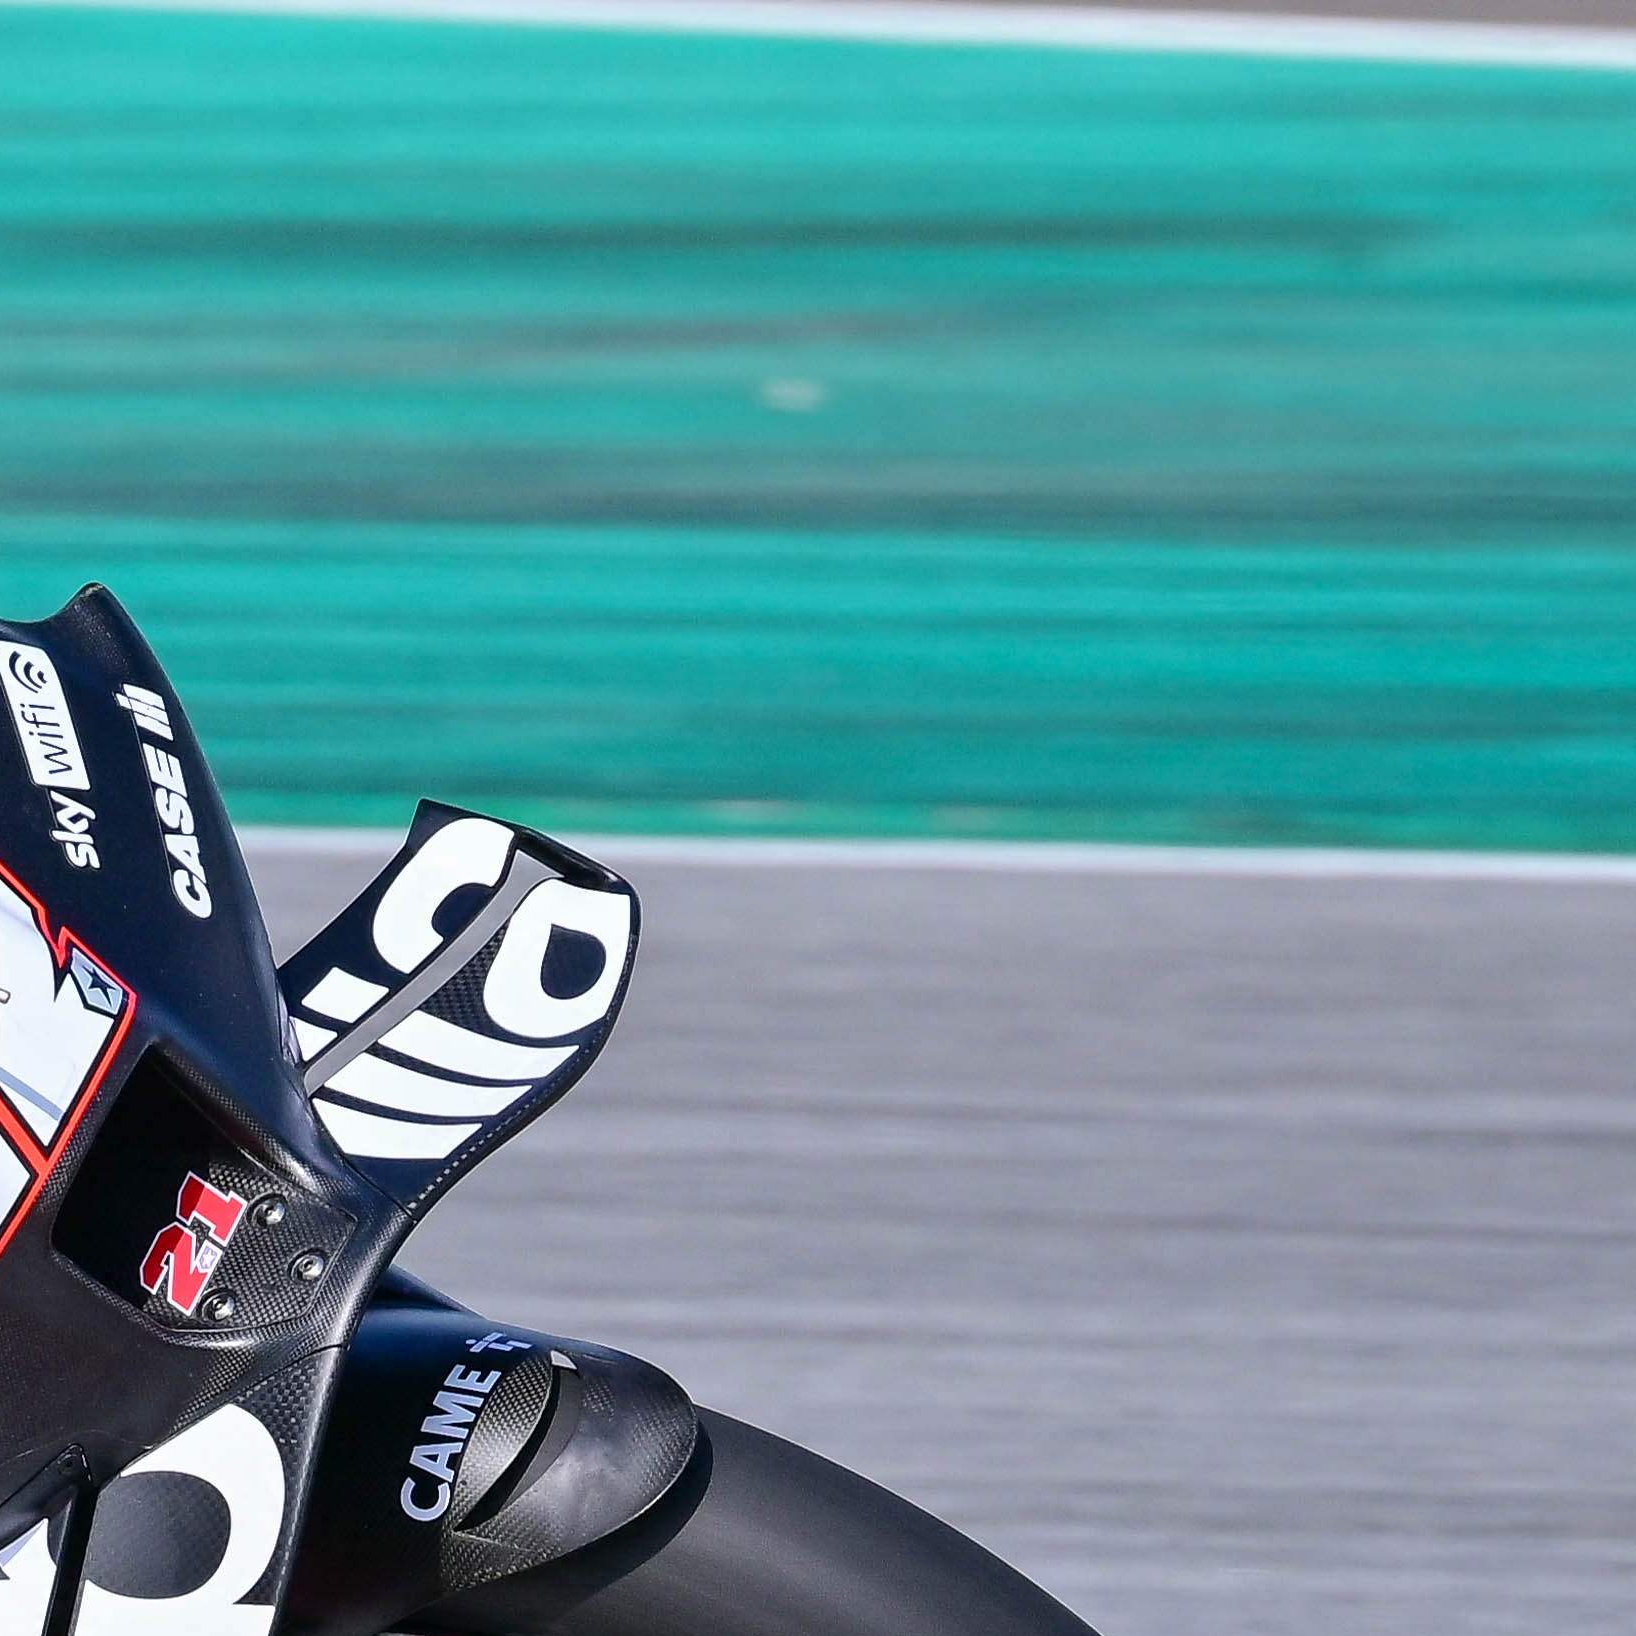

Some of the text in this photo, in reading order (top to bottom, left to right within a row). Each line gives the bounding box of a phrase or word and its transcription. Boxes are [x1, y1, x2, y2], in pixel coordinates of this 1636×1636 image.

[27, 702, 102, 869] sky wifi
[142, 752, 212, 918] CASE
[140, 1171, 247, 1315] 21
[400, 1365, 498, 1521] CAME
